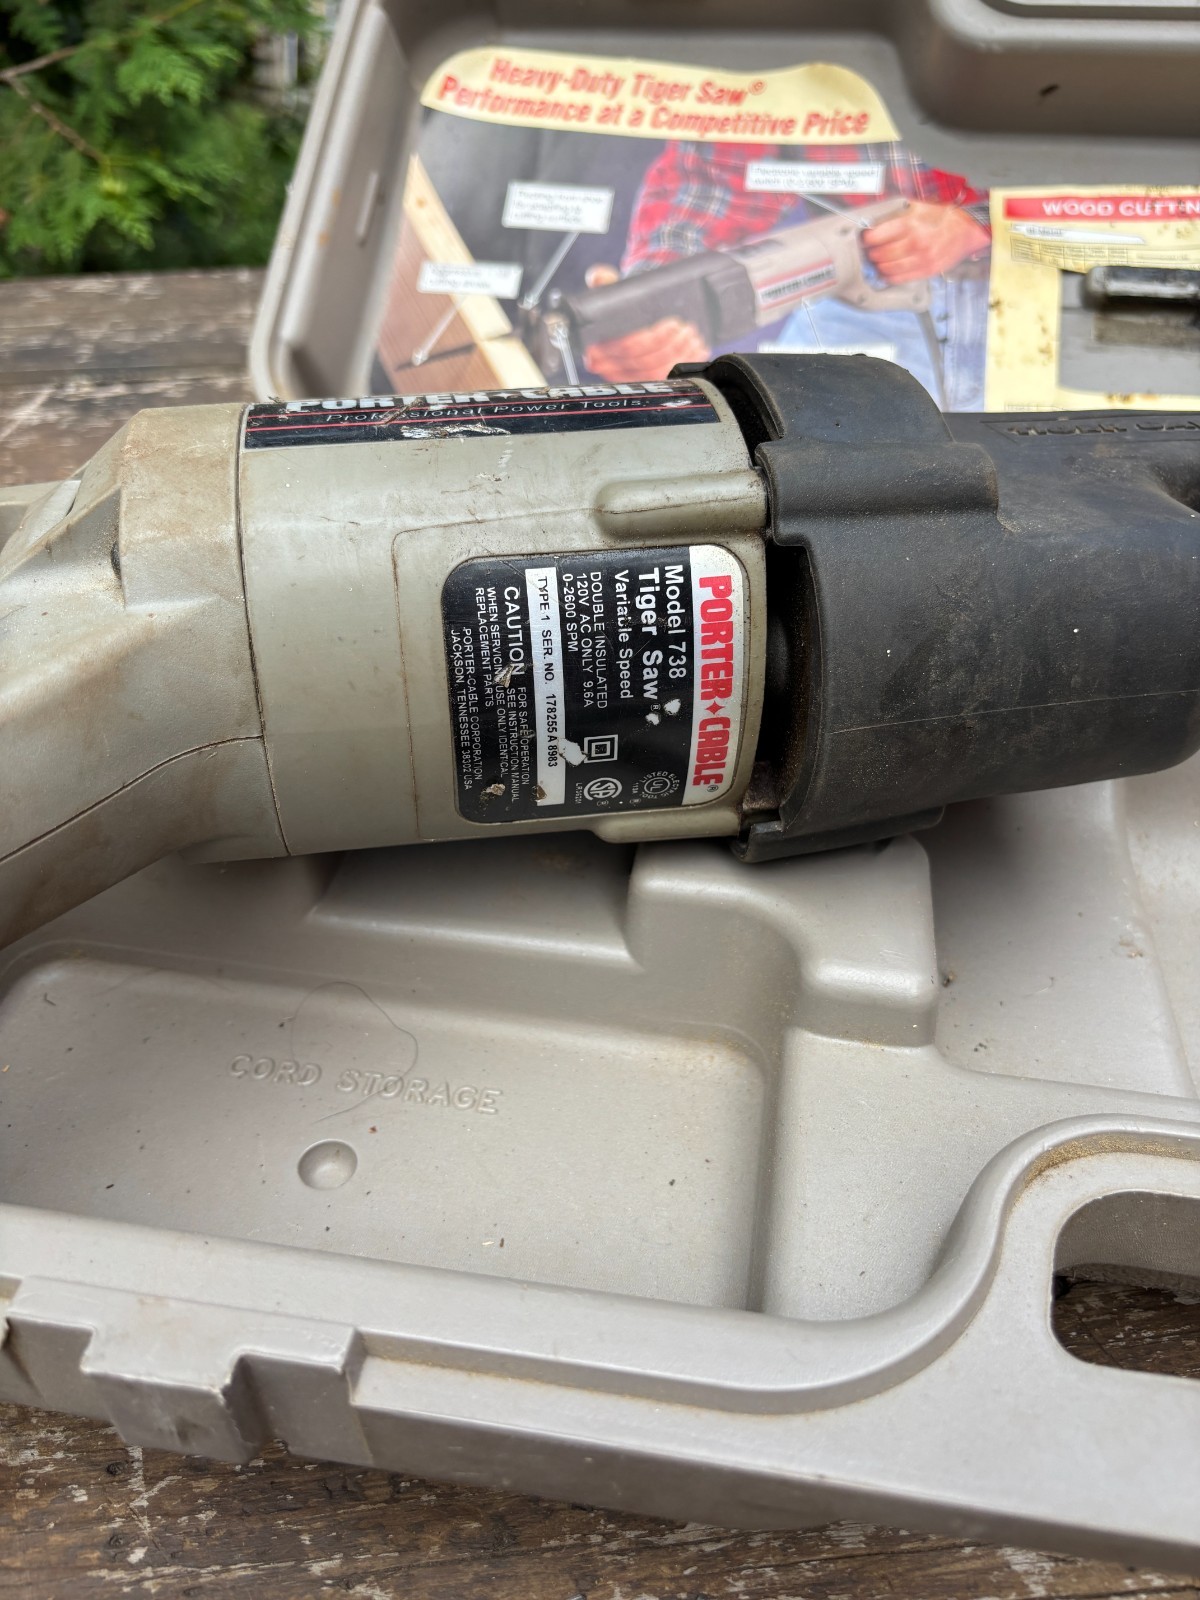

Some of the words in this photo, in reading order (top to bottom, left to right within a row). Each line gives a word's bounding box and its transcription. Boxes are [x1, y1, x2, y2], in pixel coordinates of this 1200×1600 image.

[491, 58, 624, 98] Heavy-Duty
[631, 72, 691, 104] Tiger
[697, 80, 747, 106] Saw
[437, 74, 591, 122] Performance
[597, 104, 625, 126] at
[627, 108, 645, 128] a
[650, 106, 796, 138] Competitive
[801, 110, 869, 136] Price
[1042, 200, 1115, 217] WOOD
[494, 403, 571, 414] Power
[487, 587, 498, 621] WHEN
[538, 576, 550, 610] TYPE
[563, 574, 576, 617] 0-2600
[577, 573, 589, 606] 120V
[591, 572, 604, 631] DOUBLE
[614, 570, 632, 642] Variable
[635, 567, 660, 635] Tiger
[665, 565, 685, 634] Model
[476, 588, 491, 670] REPLACEMENT
[504, 587, 525, 675] CAUTION
[567, 623, 578, 652] SPM
[580, 614, 591, 633] AC
[699, 575, 733, 700] PORTER
[490, 625, 503, 681] SERVICIN
[542, 630, 552, 659] SER.
[581, 639, 593, 673] ONLY
[668, 642, 686, 678] 738
[463, 628, 479, 713] PORTER-CABLE
[544, 663, 554, 684] NO.
[595, 636, 607, 708] INSULATED
[616, 649, 634, 698] Speed
[642, 650, 663, 699] Saw
[495, 686, 505, 705] USE
[507, 688, 516, 708] SEE
[518, 687, 527, 708] FOR
[546, 694, 557, 733] 178255
[583, 681, 593, 707] 9.6A
[457, 689, 470, 747] TENNESSEE
[497, 709, 506, 733] ONLY
[519, 711, 528, 736] SAFE
[470, 716, 482, 779] CORPORATION
[499, 736, 508, 778] IDENTICAL
[508, 711, 519, 770] INSTRUCTION
[548, 745, 557, 767] 8983
[693, 717, 730, 786] CABLE
[462, 750, 471, 772] 38302
[520, 739, 529, 784] OPERATION
[463, 775, 472, 790] USA
[511, 773, 519, 803] MANUAL
[650, 780, 663, 791] UL
[229, 1055, 322, 1087] CORD
[336, 1069, 502, 1115] STORAGE
